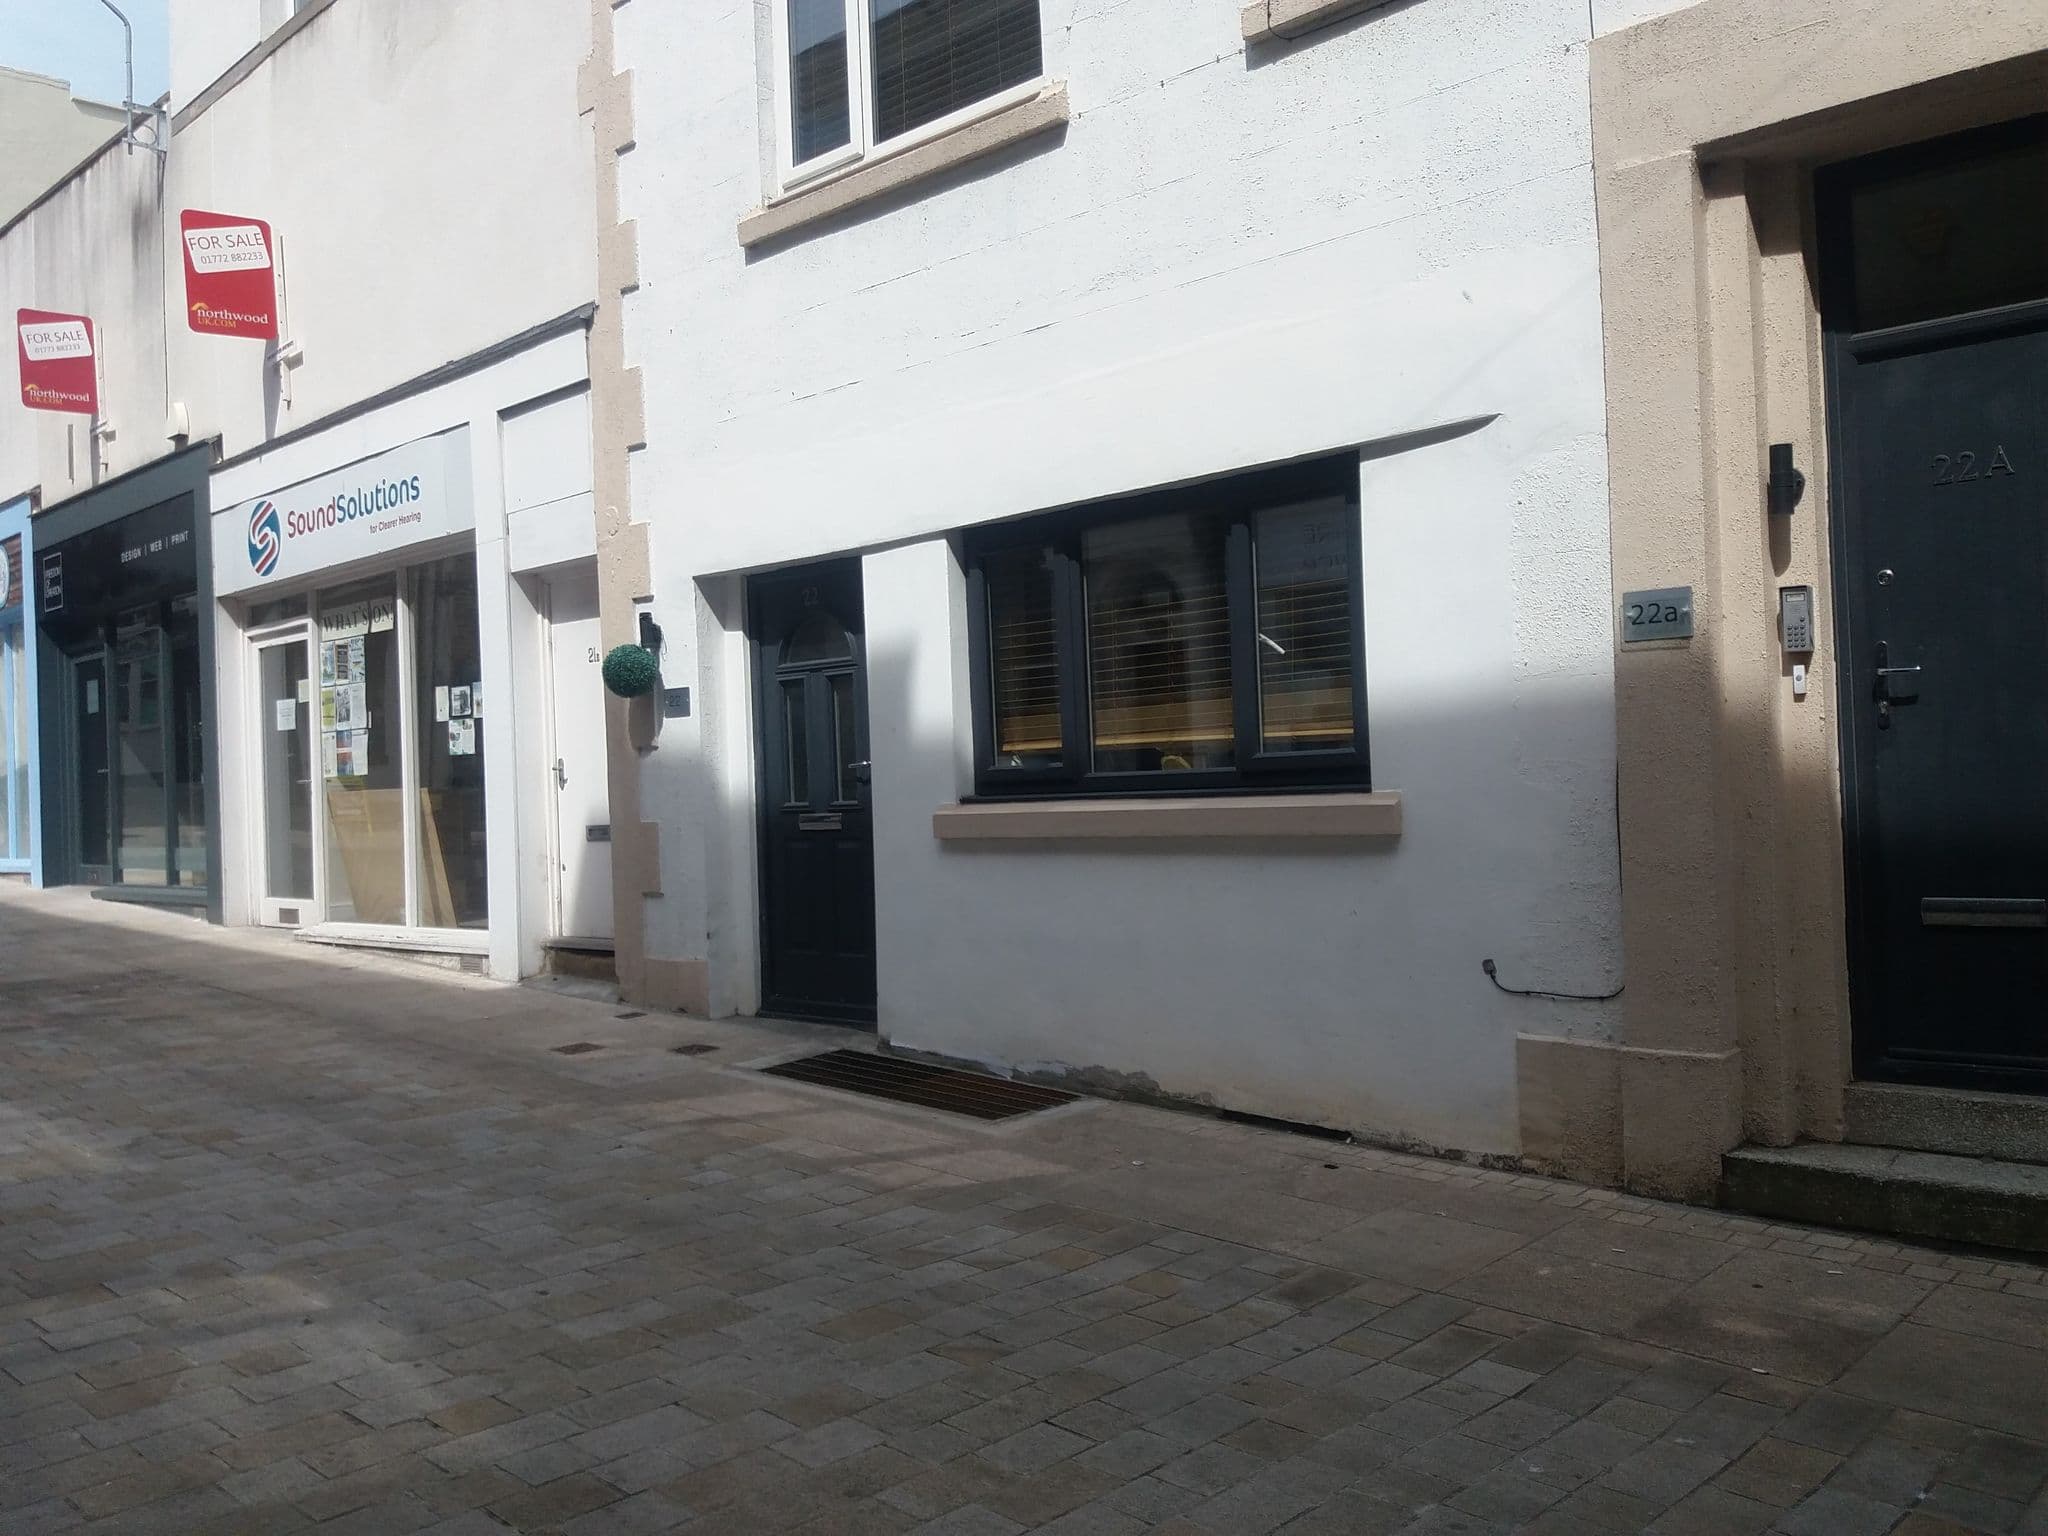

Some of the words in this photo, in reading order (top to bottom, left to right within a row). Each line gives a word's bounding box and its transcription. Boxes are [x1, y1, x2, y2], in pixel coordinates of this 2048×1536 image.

[188, 236, 222, 251] FOR
[226, 232, 264, 248] SALE
[200, 254, 229, 265] 01772
[231, 251, 263, 262] 882233
[197, 309, 269, 324] northwood
[197, 318, 236, 328] UK.COM
[26, 332, 52, 345] FOR
[54, 330, 84, 342] SALE
[29, 388, 90, 402] northwood
[287, 475, 421, 539] SoundSolutions
[369, 523, 378, 534] for
[378, 518, 398, 533] Clearer
[398, 511, 421, 527] Hearing
[120, 548, 142, 563] DESIGN
[149, 540, 162, 552] WEB
[171, 530, 189, 545] PRINT
[1631, 603, 1679, 626] 22a
